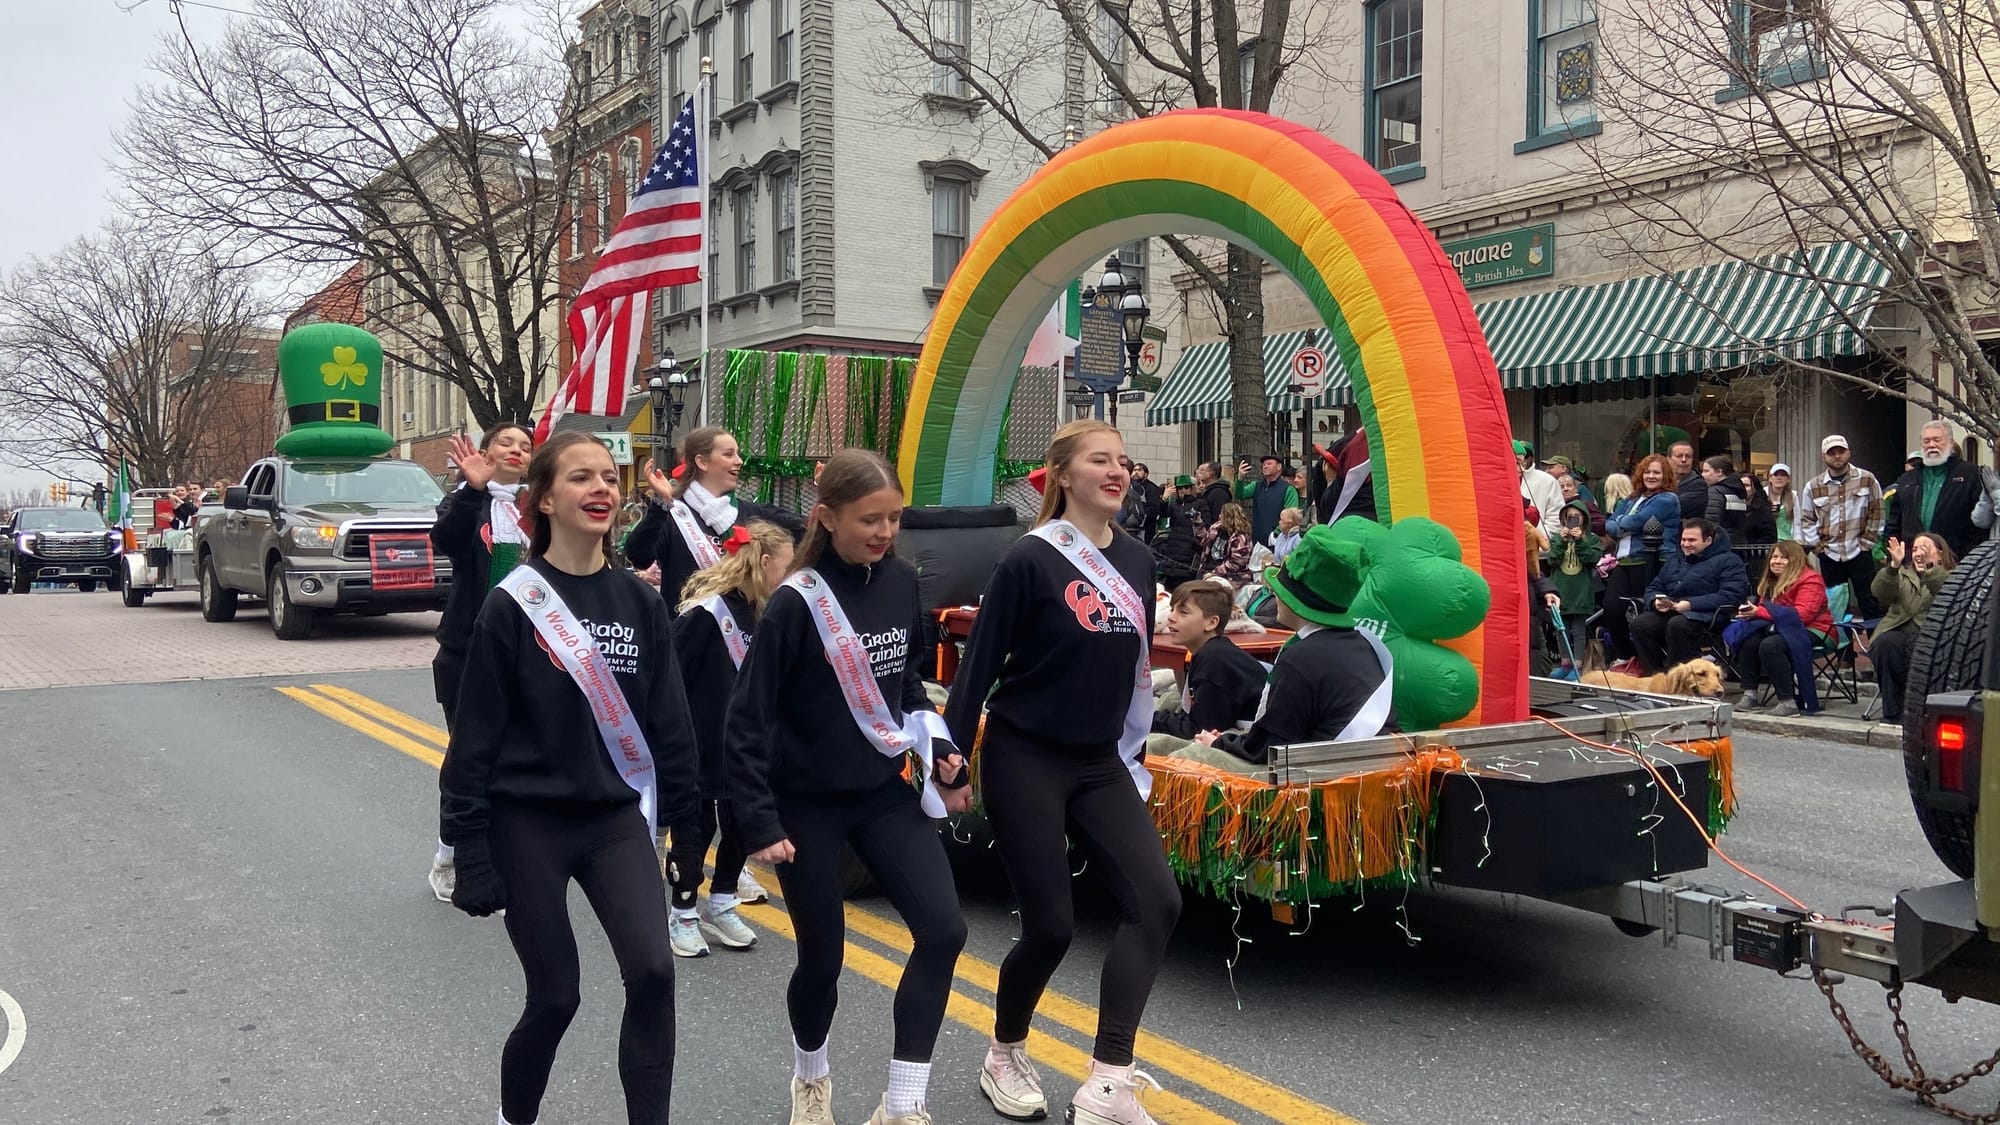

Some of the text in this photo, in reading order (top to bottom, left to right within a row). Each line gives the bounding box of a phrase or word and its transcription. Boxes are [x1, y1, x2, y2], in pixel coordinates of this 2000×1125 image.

[1475, 268, 1502, 283] British
[1506, 265, 1524, 278] Isles
[1078, 547, 1107, 578] World
[545, 610, 580, 648] World
[574, 648, 621, 728] Championships
[816, 595, 841, 634] World
[836, 636, 874, 715] Championships
